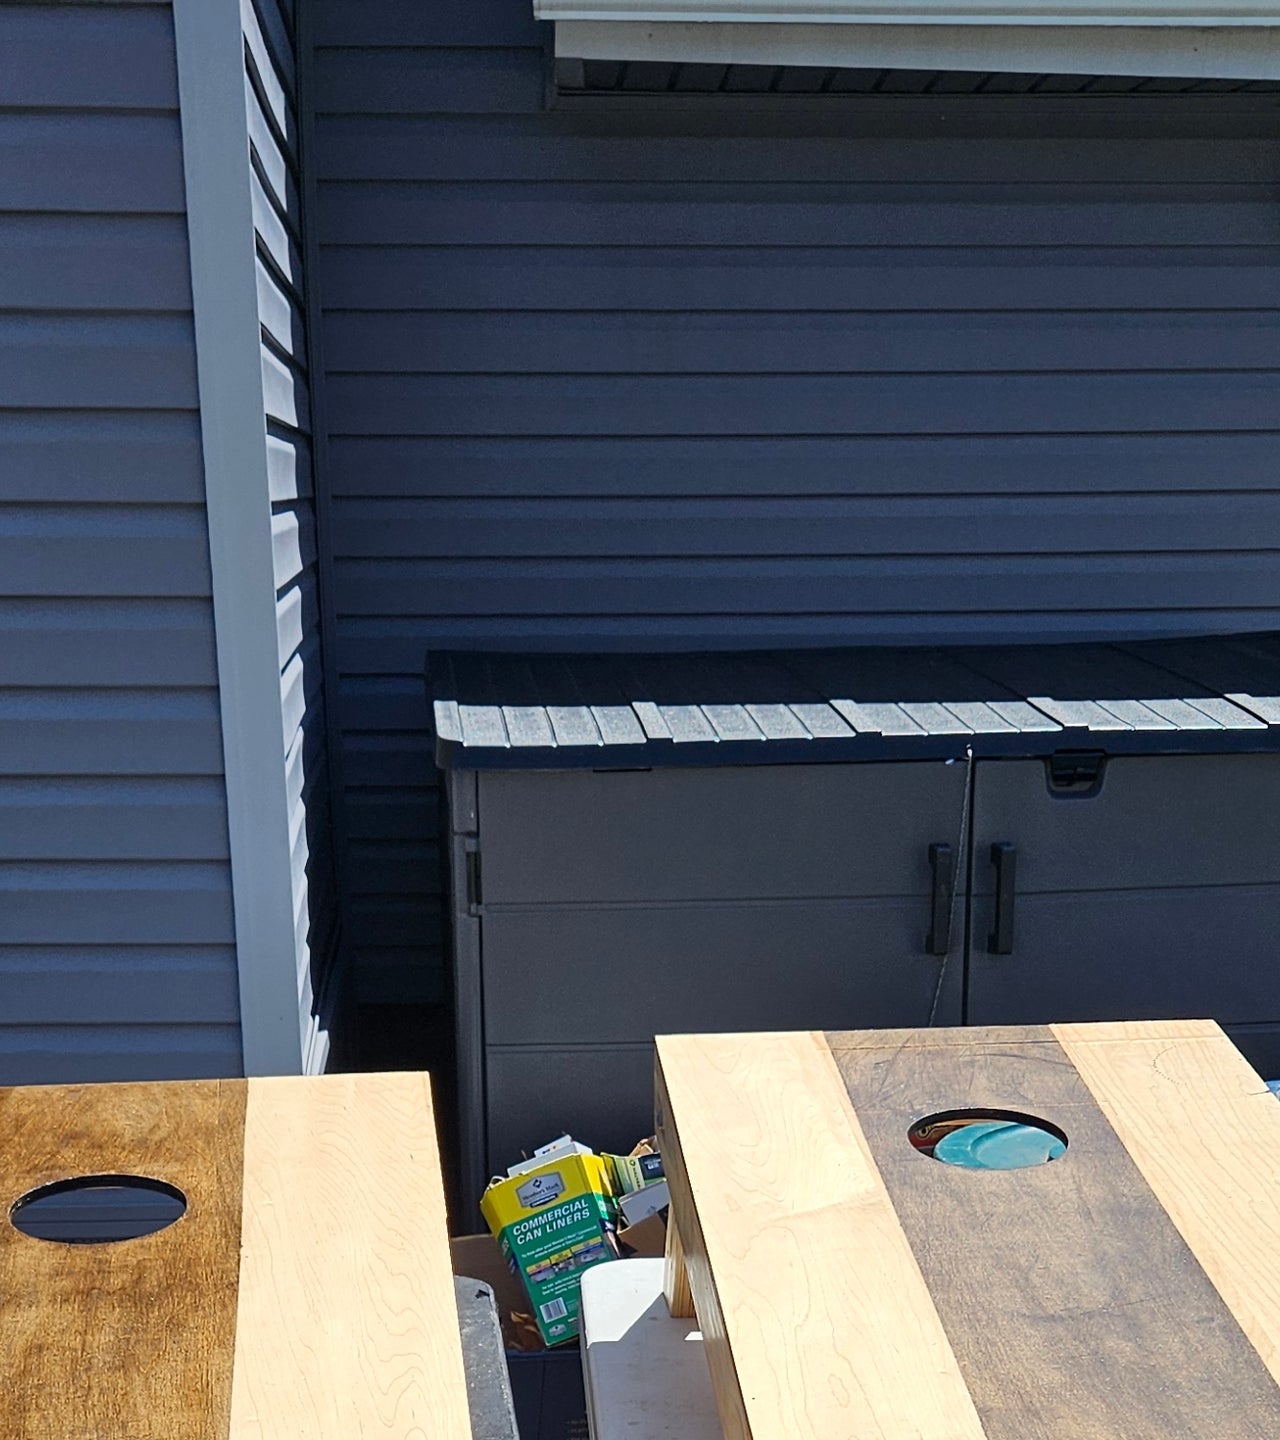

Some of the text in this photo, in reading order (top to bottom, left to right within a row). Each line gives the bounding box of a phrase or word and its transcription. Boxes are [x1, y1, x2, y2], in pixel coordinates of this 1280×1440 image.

[513, 1199, 589, 1236] COMMERCIAL
[517, 1227, 542, 1245] CAN
[546, 1208, 590, 1233] LINERS
